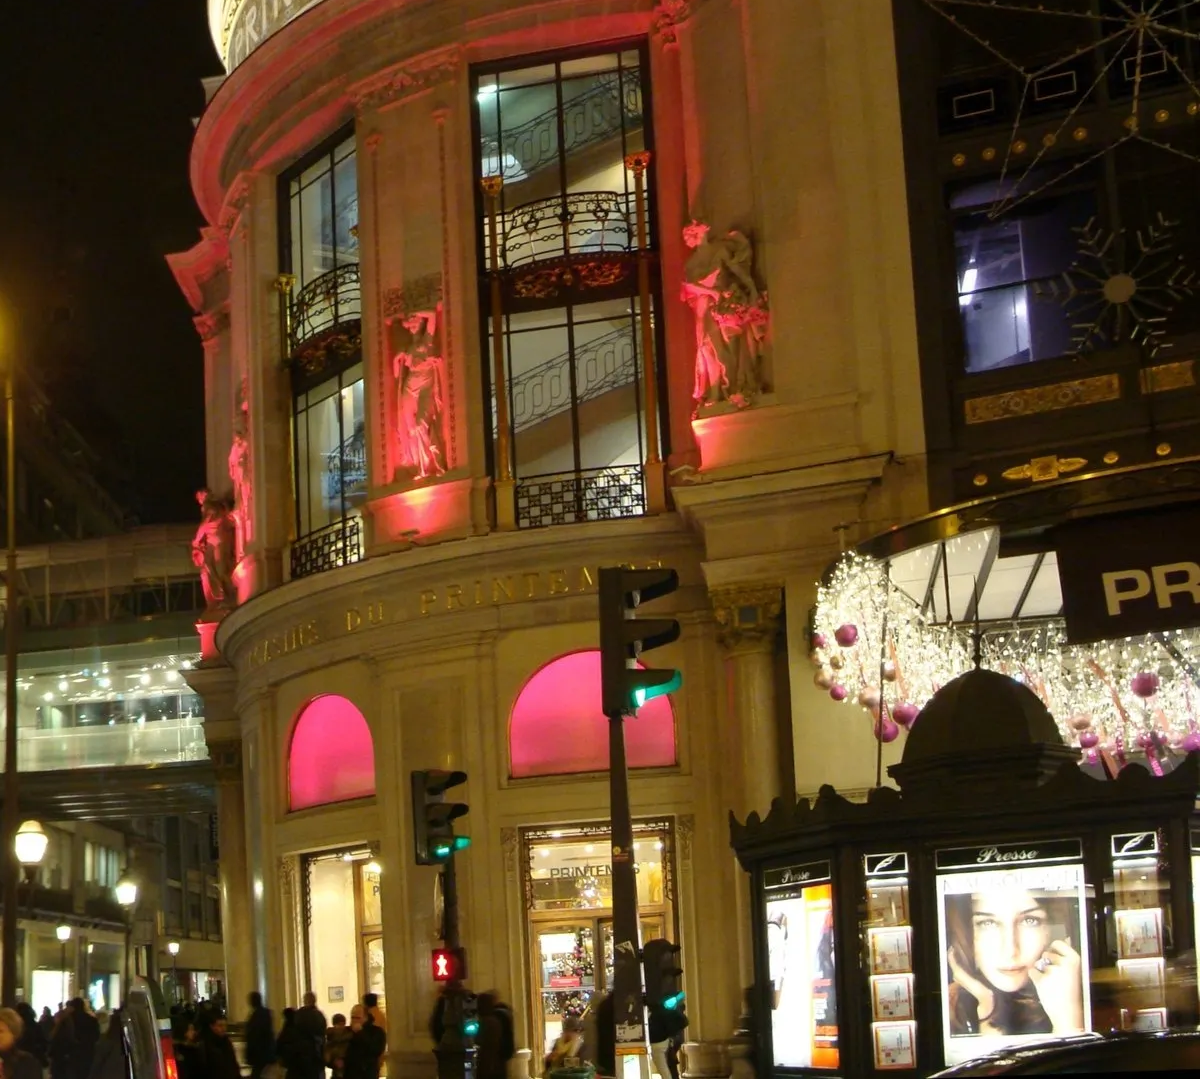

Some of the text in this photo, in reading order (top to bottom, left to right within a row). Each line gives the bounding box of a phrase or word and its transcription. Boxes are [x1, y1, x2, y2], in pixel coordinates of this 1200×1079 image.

[1101, 561, 1200, 617] PR
[346, 602, 384, 632] DU
[976, 846, 1040, 863] Presse
[550, 862, 640, 878] PRINTES
